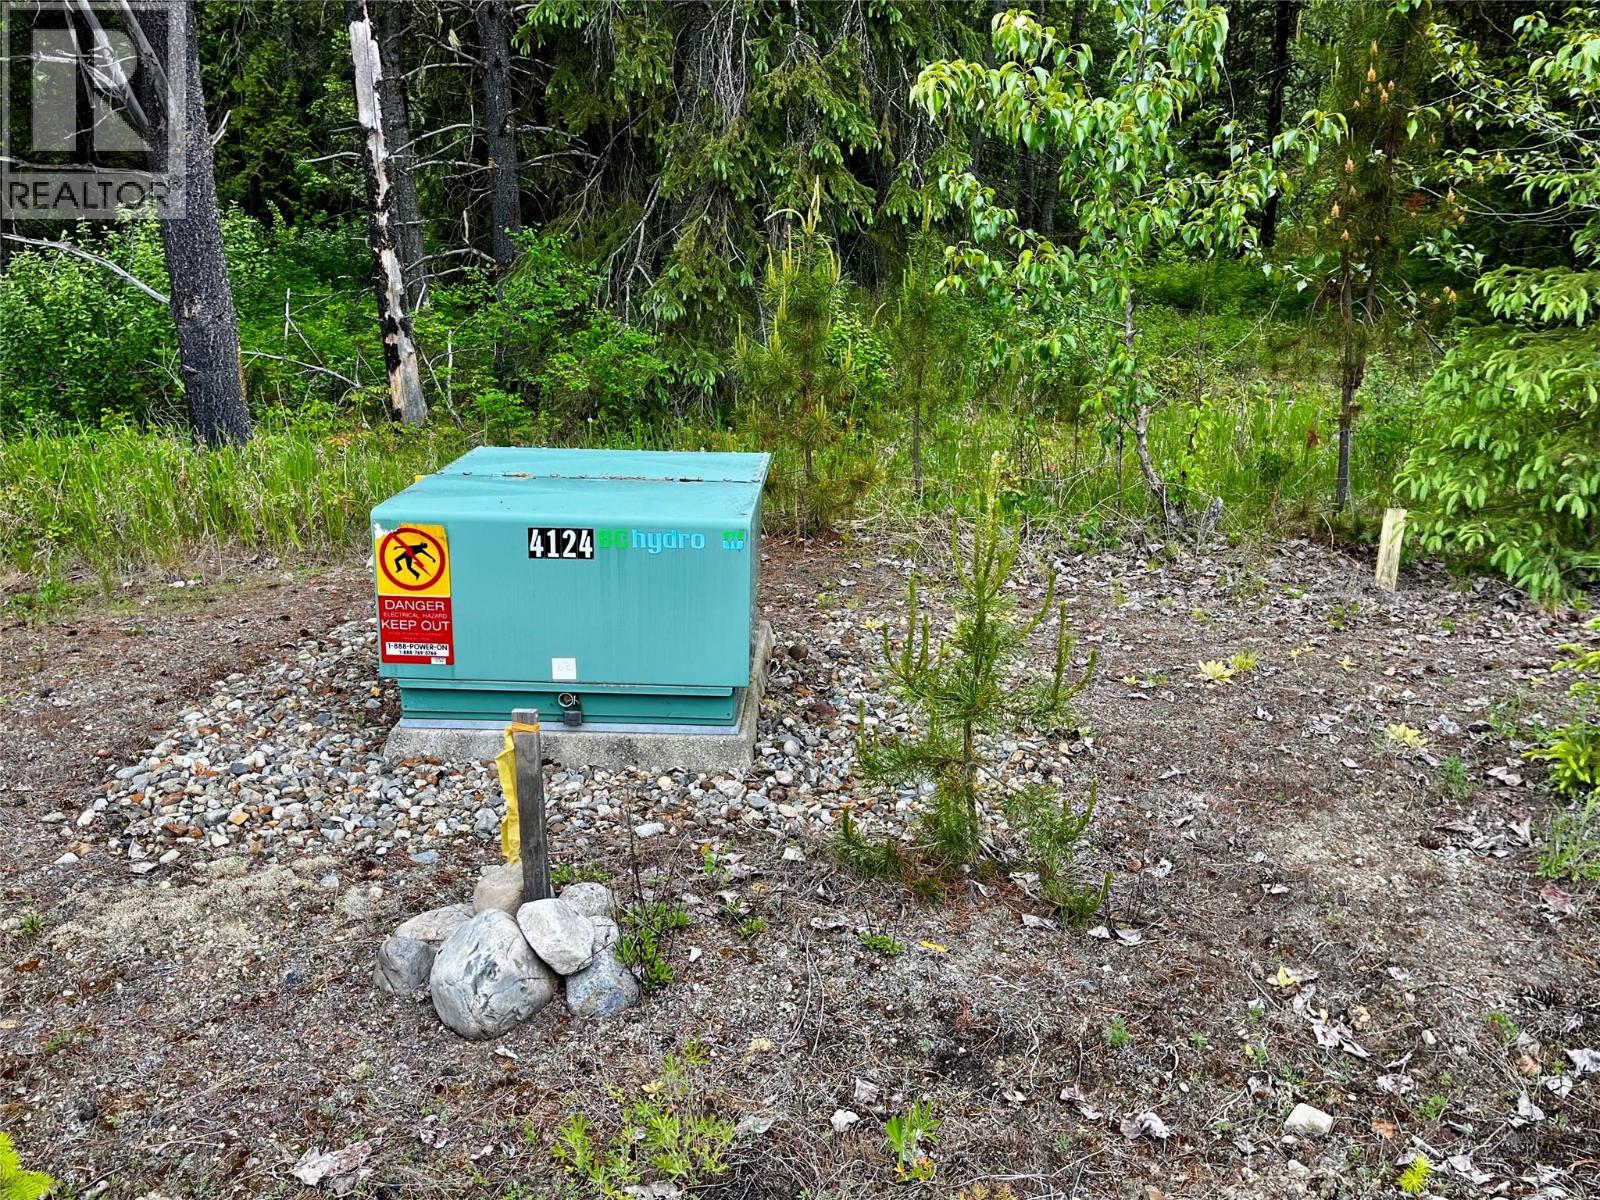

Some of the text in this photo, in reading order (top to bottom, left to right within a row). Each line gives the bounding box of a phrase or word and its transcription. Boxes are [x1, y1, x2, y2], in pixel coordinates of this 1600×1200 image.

[529, 529, 593, 558] 4124
[598, 528, 706, 553] BC hydro
[384, 599, 445, 611] DANGER
[381, 619, 450, 631] KEEP OUT
[387, 643, 448, 651] 1-888-POWER-ON
